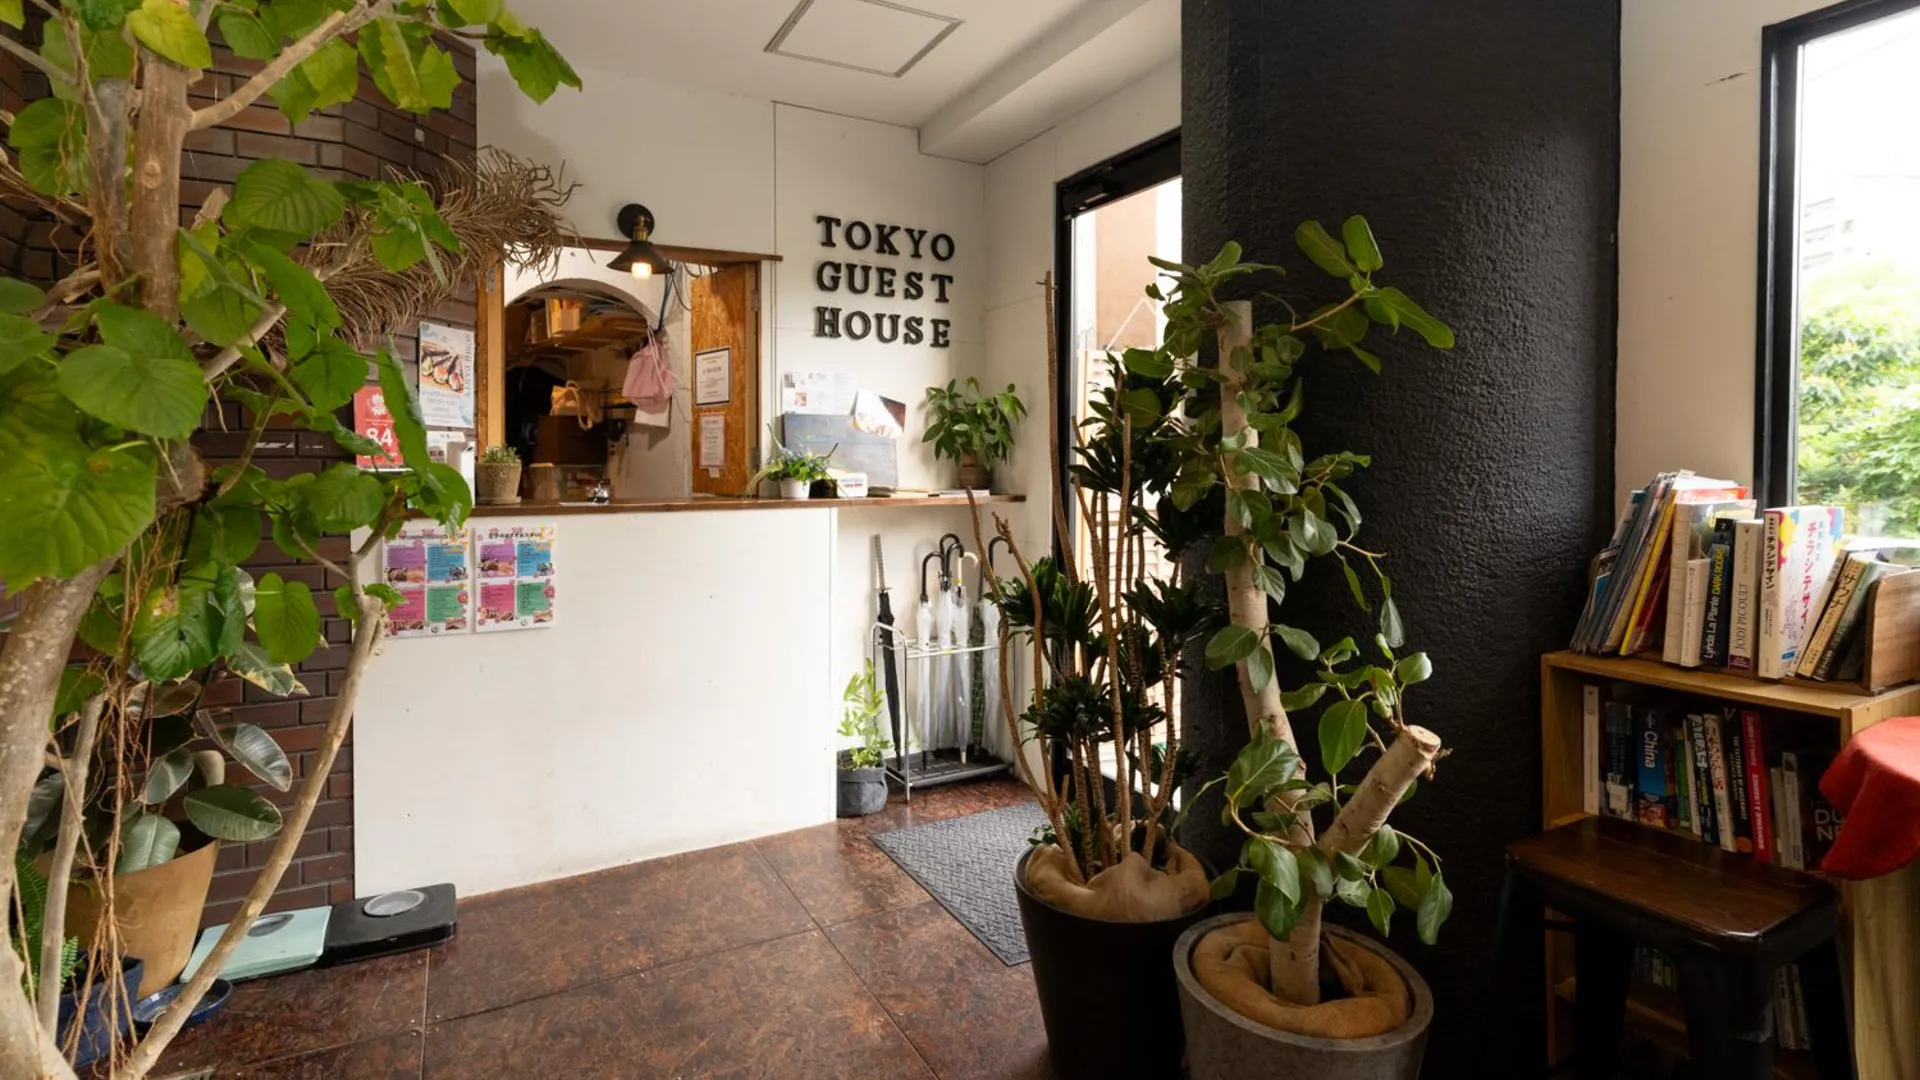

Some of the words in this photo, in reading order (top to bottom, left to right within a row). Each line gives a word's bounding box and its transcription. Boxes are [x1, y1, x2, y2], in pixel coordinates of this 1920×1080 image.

[815, 215, 955, 262] TOKYO
[816, 260, 953, 303] GUEST
[815, 306, 950, 348] HOUSE
[1714, 546, 1725, 573] ROOMS
[1800, 521, 1817, 631] チラシデザイ
[1712, 574, 1722, 595] DARK
[1707, 596, 1720, 621] Plante
[1736, 581, 1749, 626] PICOULT
[1706, 622, 1716, 634] La
[1735, 627, 1748, 650] JODI
[1703, 635, 1716, 659] Lynda
[1644, 730, 1659, 769] China
